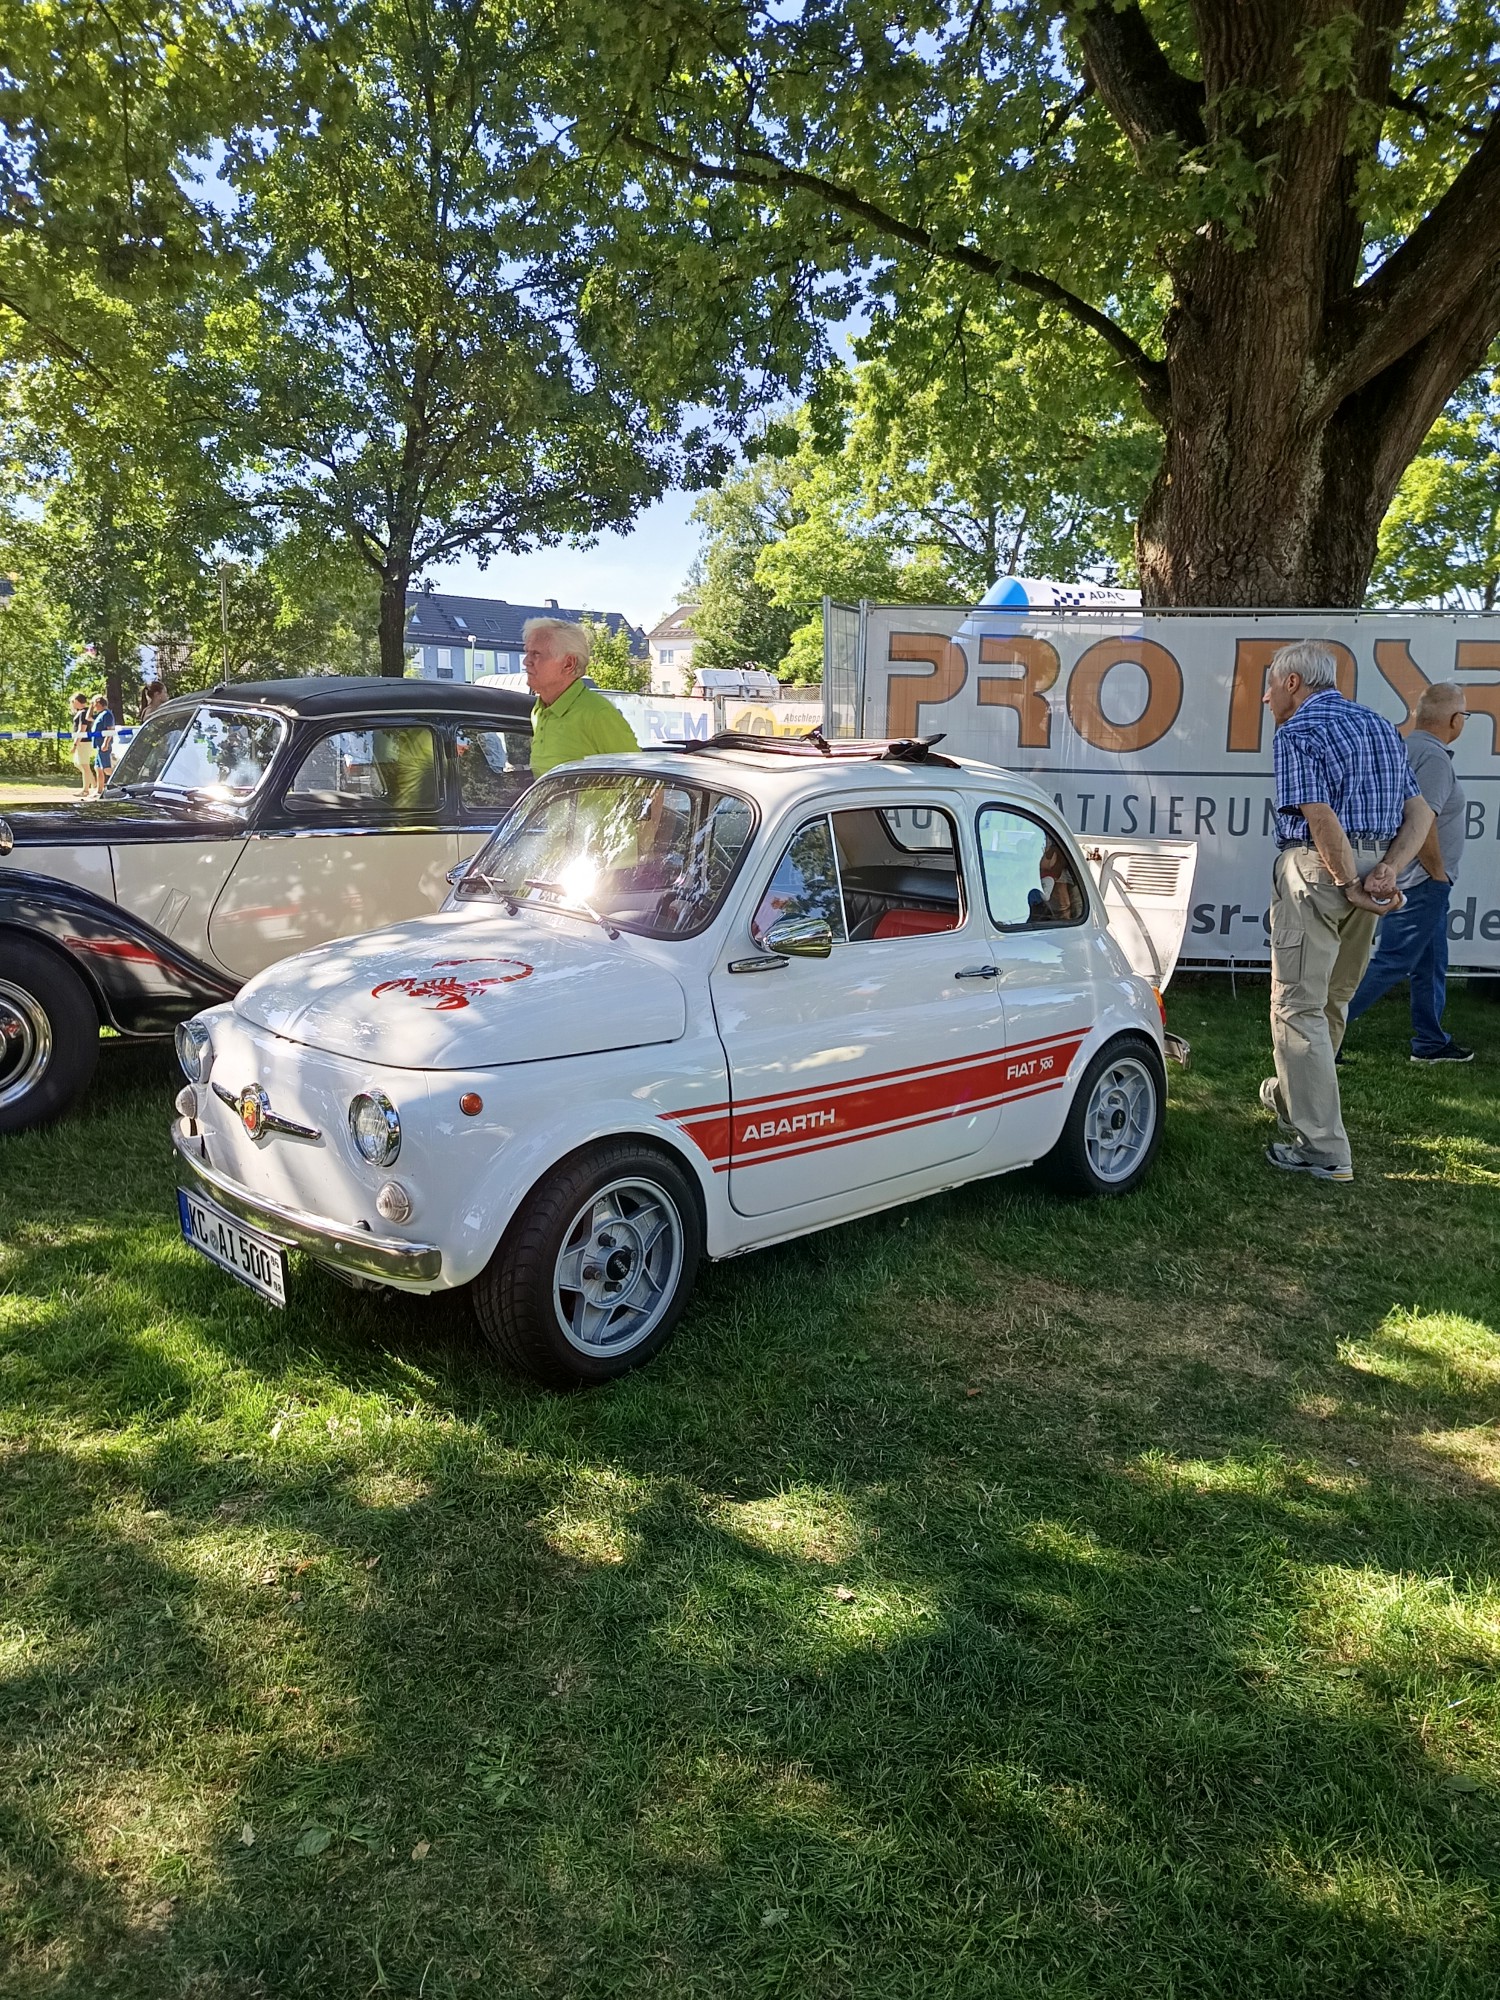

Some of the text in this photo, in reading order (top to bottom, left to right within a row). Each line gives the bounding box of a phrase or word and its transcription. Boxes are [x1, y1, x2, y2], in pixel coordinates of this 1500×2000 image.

[1090, 591, 1125, 601] ADAC
[886, 630, 1184, 753] PRO
[644, 709, 708, 740] REM
[1446, 896, 1500, 941] de
[1007, 1055, 1054, 1080] FIAT 500
[741, 1108, 835, 1143] ABARTH
[188, 1203, 272, 1288] KC AI 500
